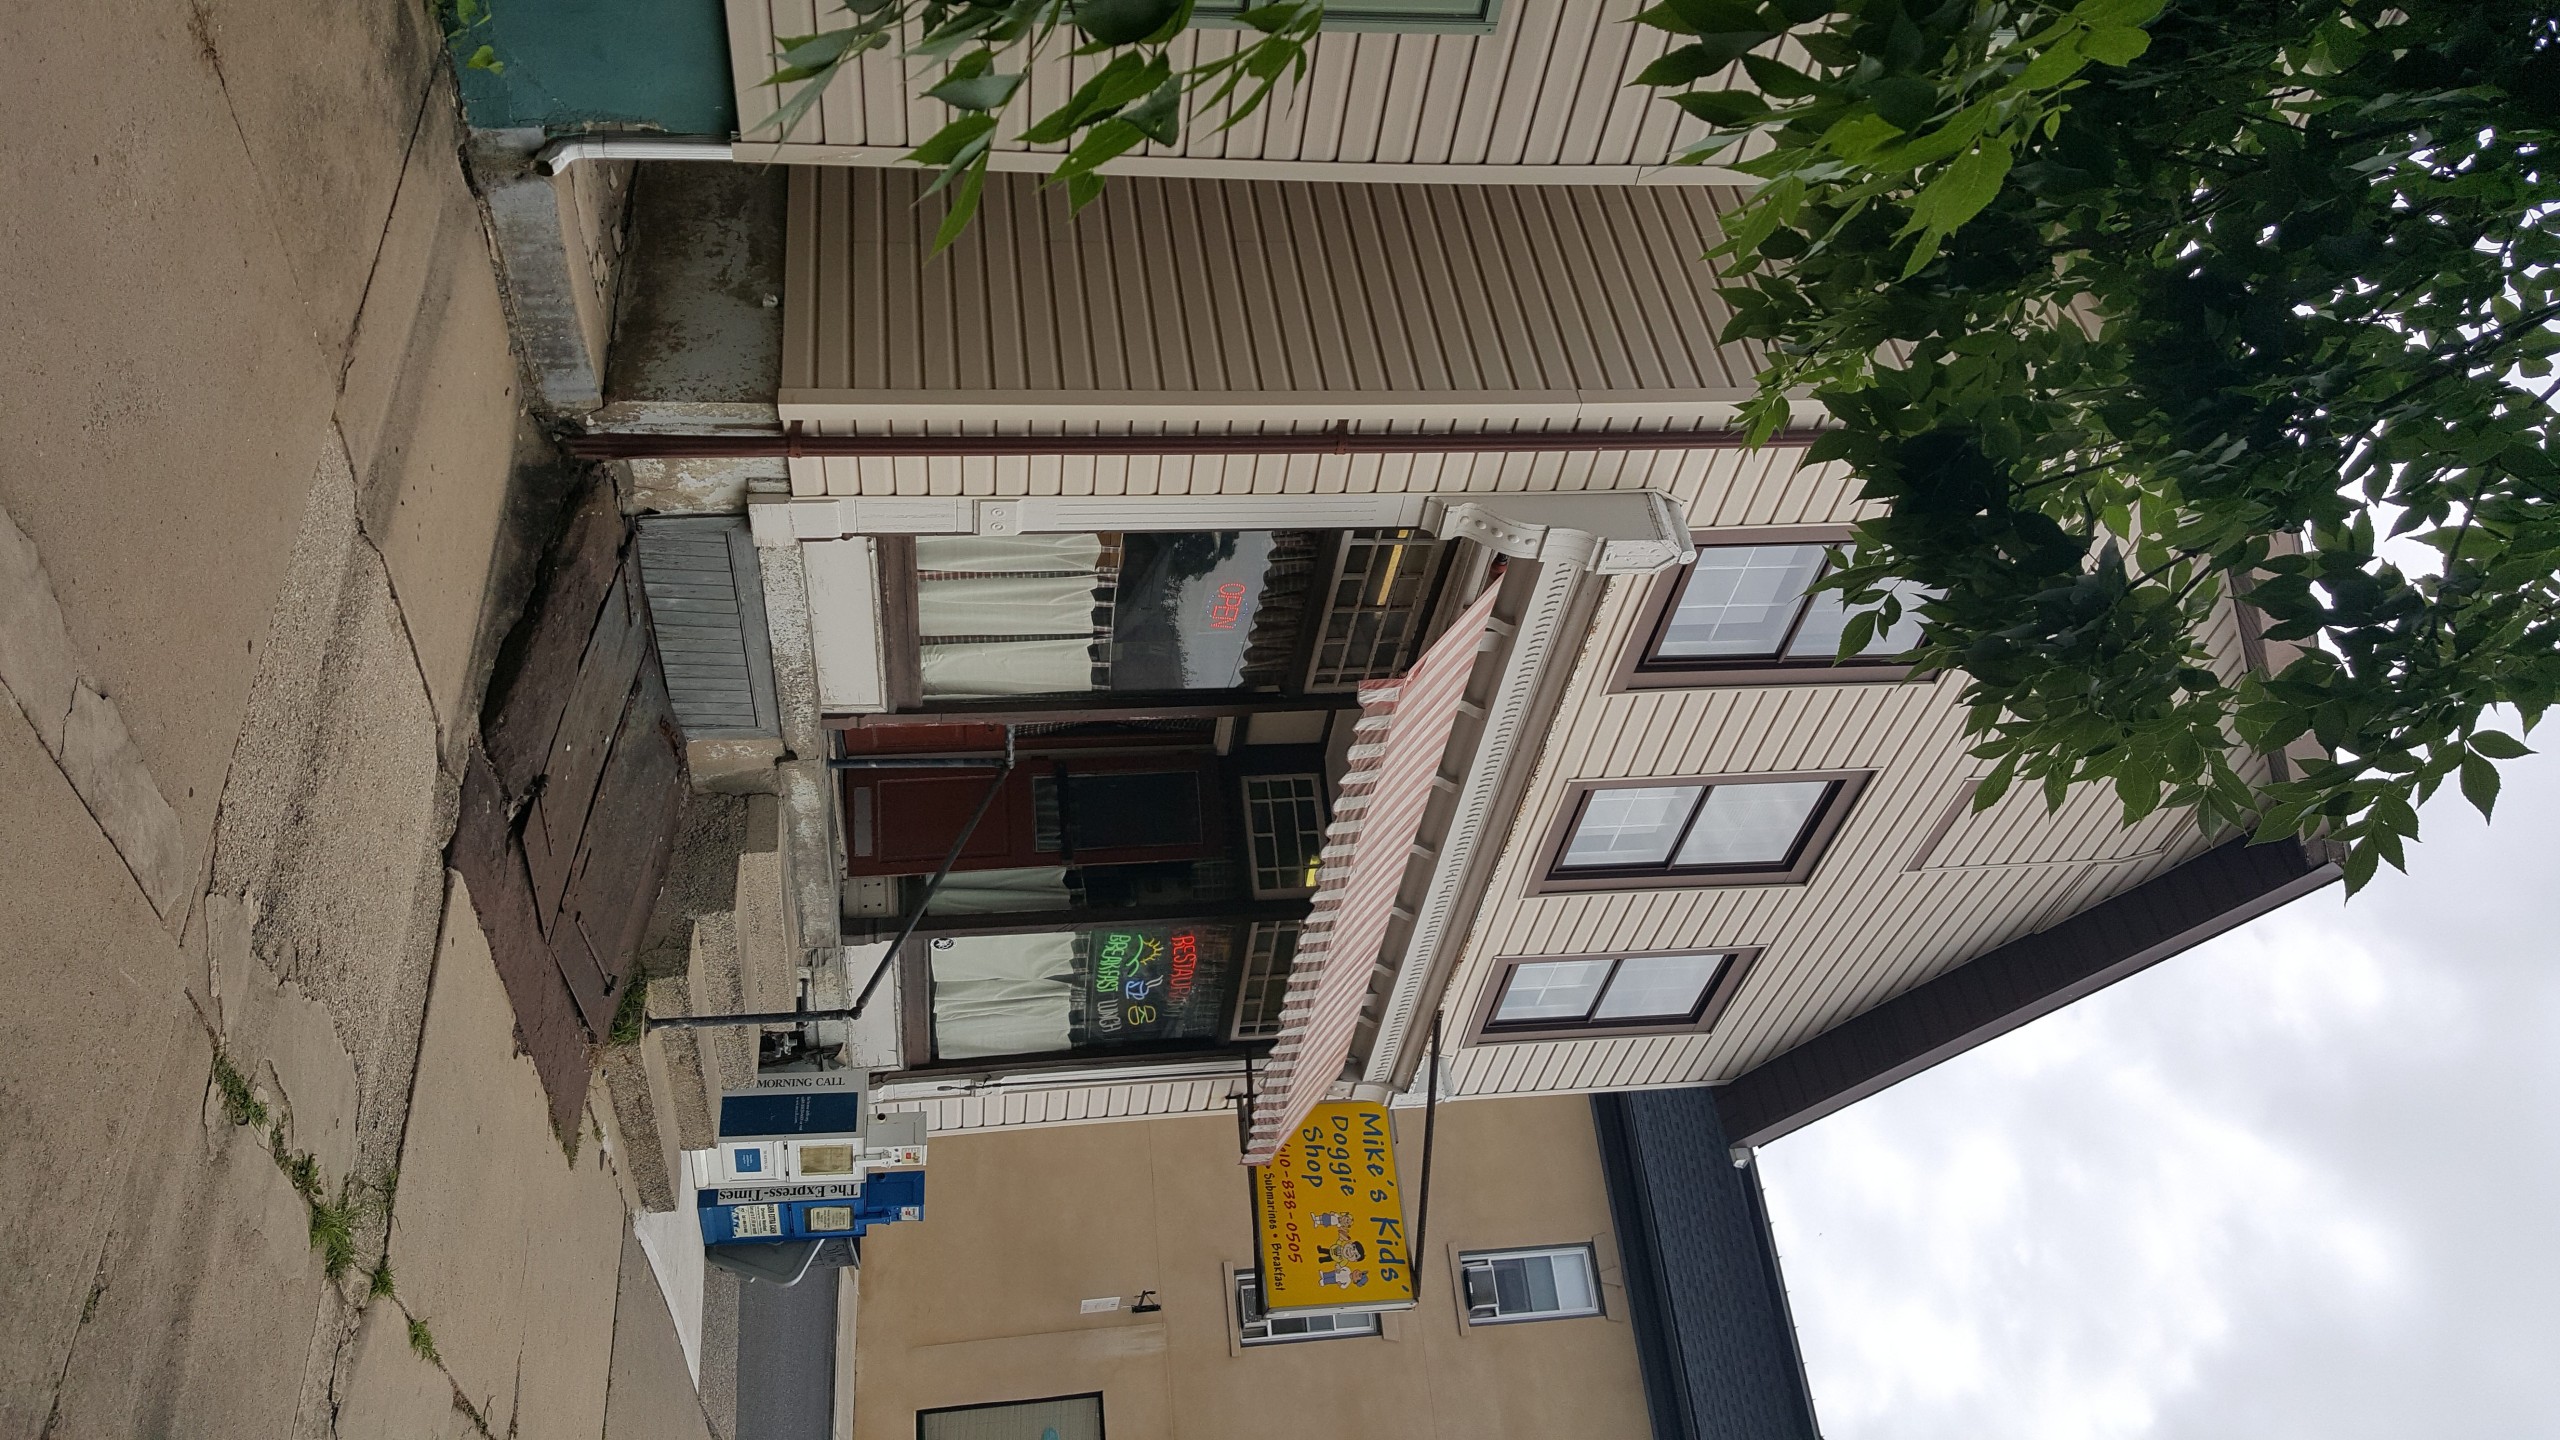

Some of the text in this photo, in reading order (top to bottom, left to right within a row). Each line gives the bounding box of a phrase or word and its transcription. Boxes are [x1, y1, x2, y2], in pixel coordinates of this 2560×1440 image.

[1210, 583, 1246, 629] OPEN
[1096, 934, 1132, 1033] BREAKFAST LUNCH
[1162, 935, 1197, 1017] RESTAURANT
[756, 1077, 846, 1089] MORNING CALL
[1301, 1126, 1325, 1188] Shop
[1327, 1116, 1357, 1196] Doggie
[718, 1183, 858, 1202] The Express-Times
[768, 1213, 777, 1224] EXTRA
[1359, 1113, 1409, 1293] Mike's Kids'
[769, 1224, 778, 1234] CASH
[1263, 1172, 1287, 1291] Submarines Breakfast
